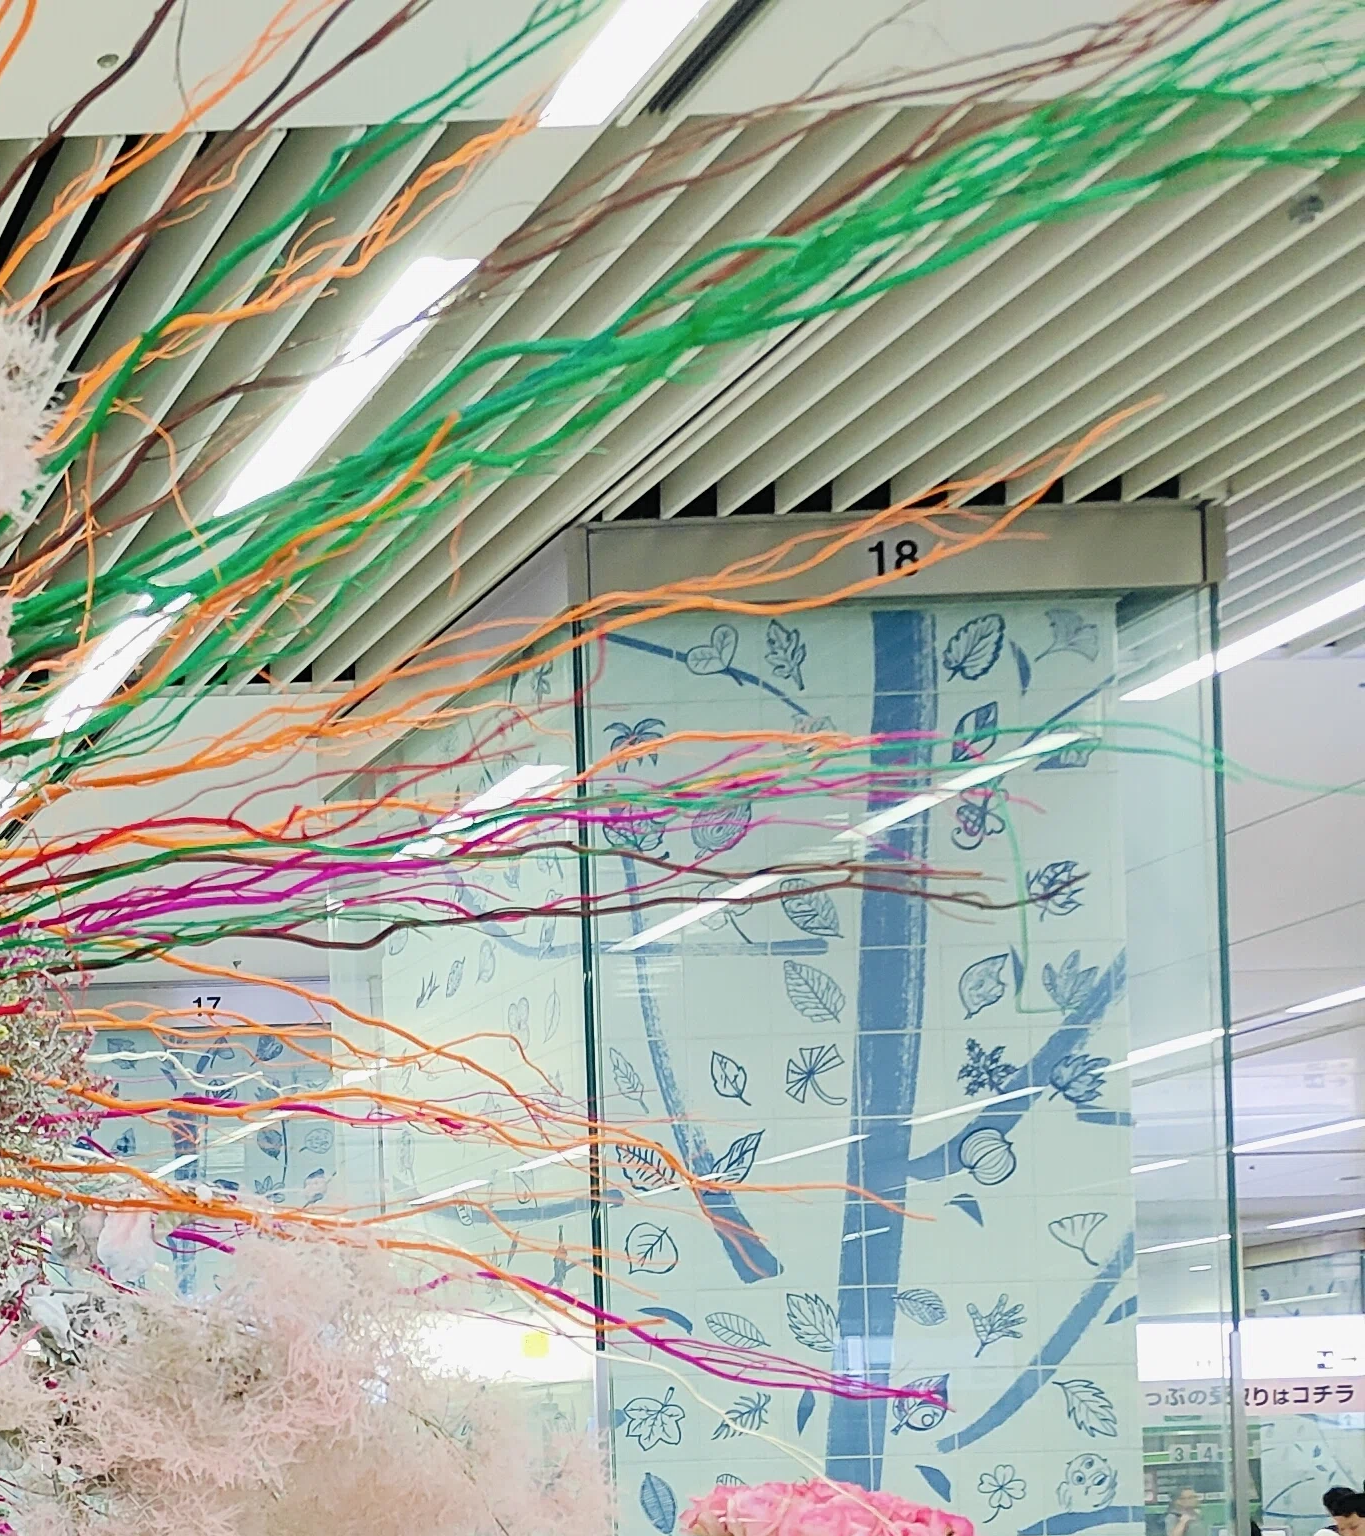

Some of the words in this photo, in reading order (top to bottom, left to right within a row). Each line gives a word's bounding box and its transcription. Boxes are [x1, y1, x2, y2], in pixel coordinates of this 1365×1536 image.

[868, 539, 919, 576] 18
[192, 996, 222, 1018] 17
[1144, 1384, 1355, 1407] つぶの受りはコチラ
[1174, 1447, 1184, 1462] 3
[1203, 1446, 1213, 1461] 4
